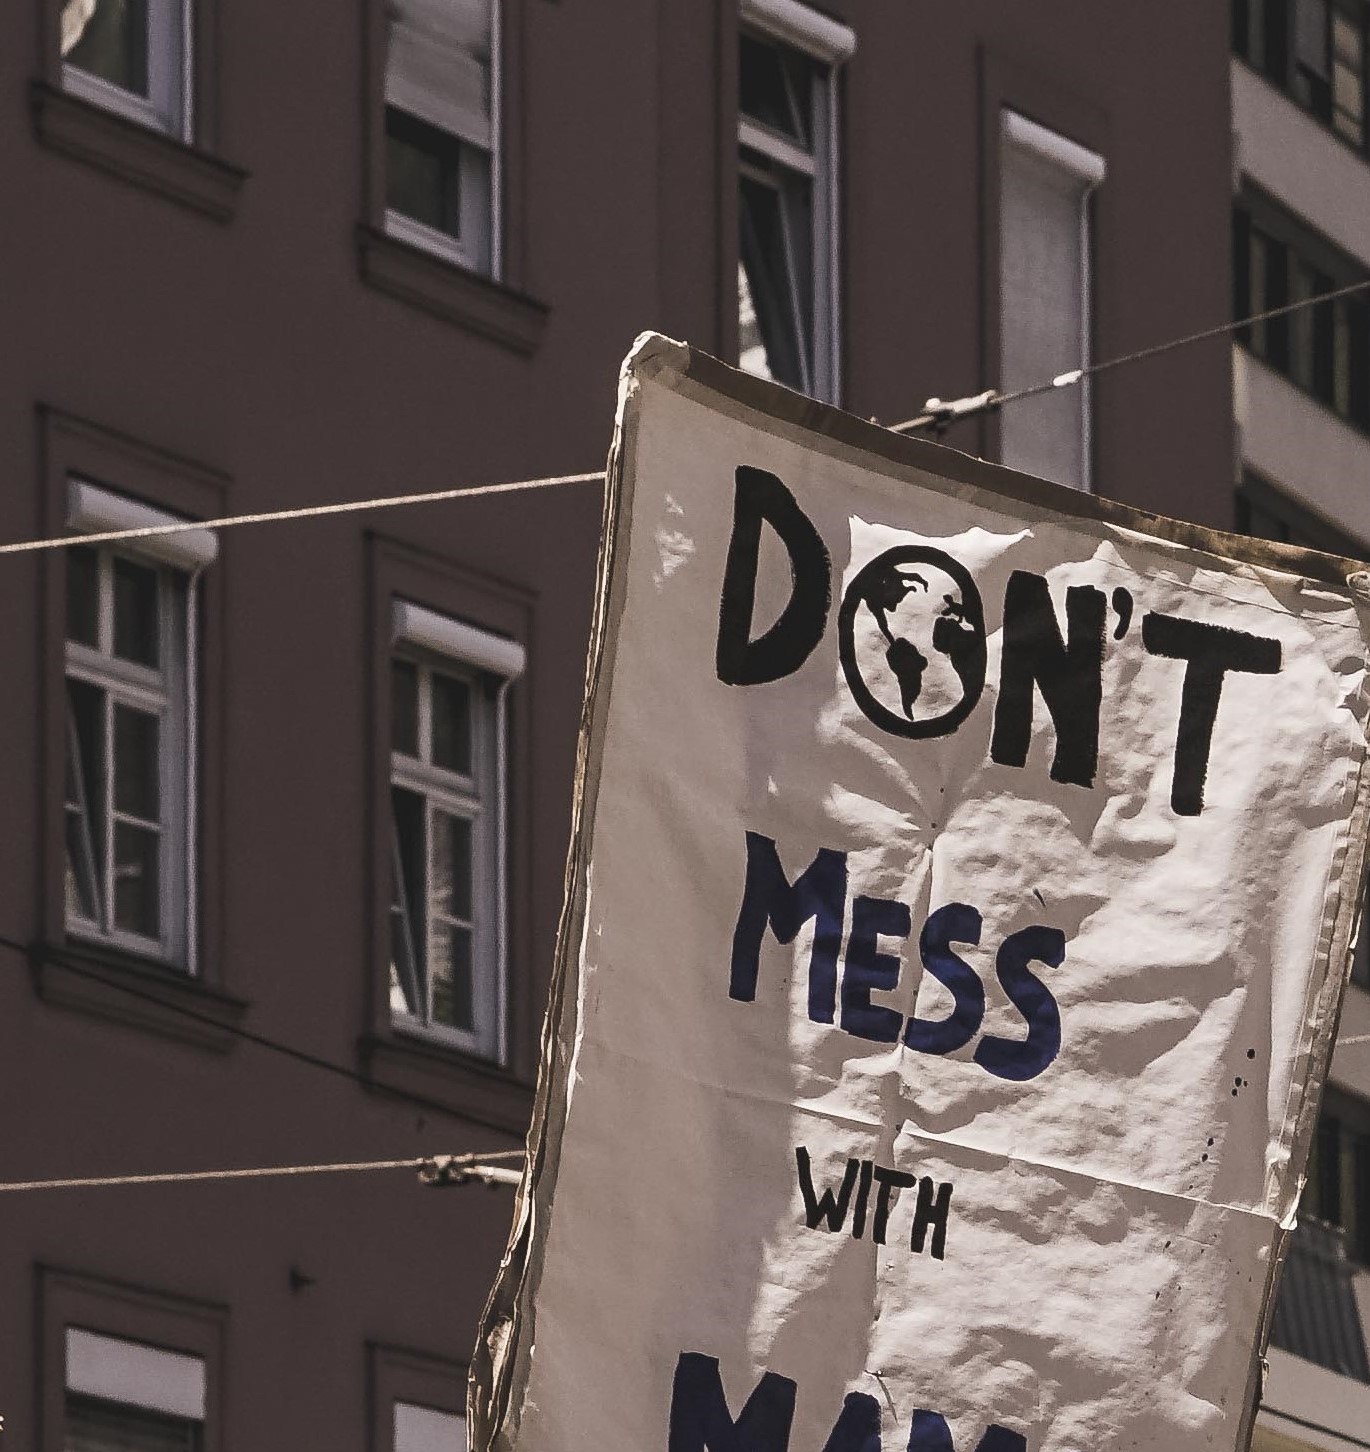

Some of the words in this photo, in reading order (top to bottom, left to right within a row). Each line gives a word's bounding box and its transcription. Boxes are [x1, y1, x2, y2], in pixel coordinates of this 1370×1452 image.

[716, 465, 1283, 817] DON'T
[728, 831, 1067, 1082] MESS
[794, 1146, 954, 1261] WITH
